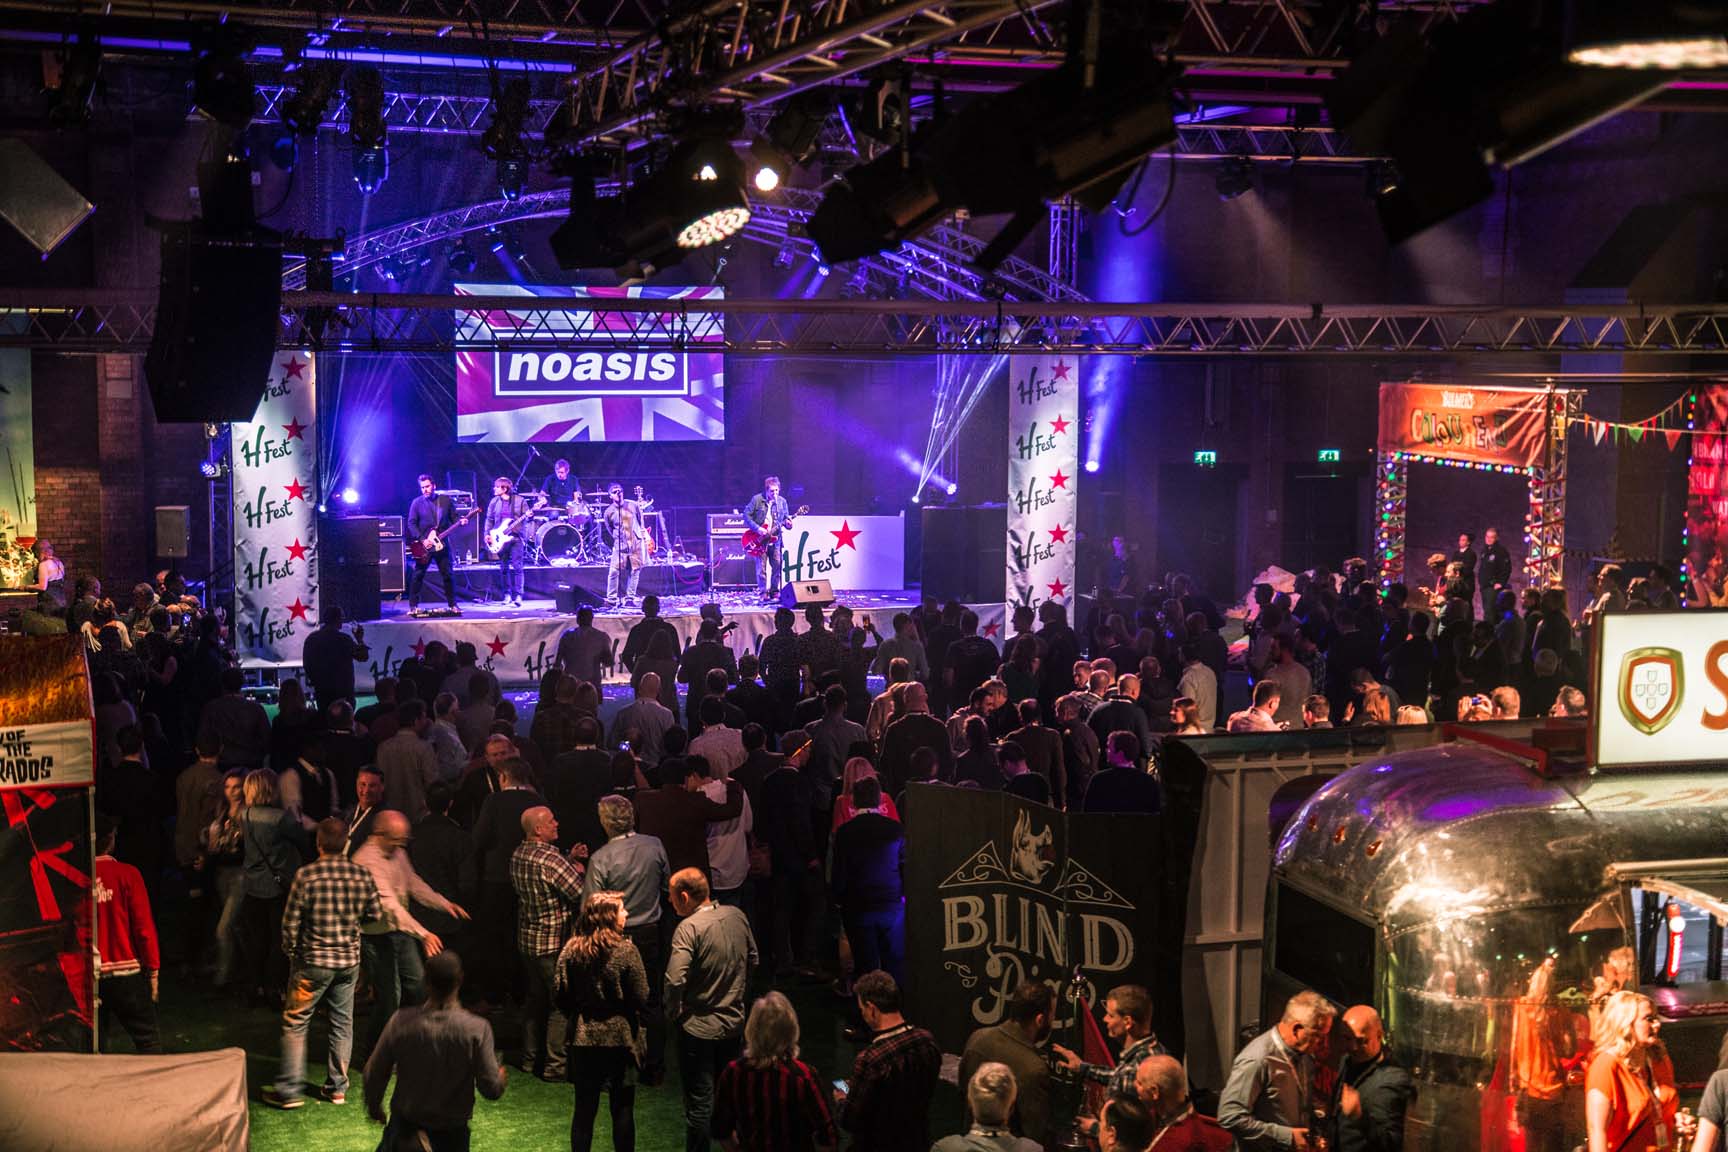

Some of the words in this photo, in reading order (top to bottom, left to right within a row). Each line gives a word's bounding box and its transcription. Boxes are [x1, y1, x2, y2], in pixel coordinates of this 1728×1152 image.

[508, 353, 676, 381] noasis
[6, 729, 26, 742] OF
[3, 741, 32, 757] THE
[942, 893, 1134, 972] BLIND
